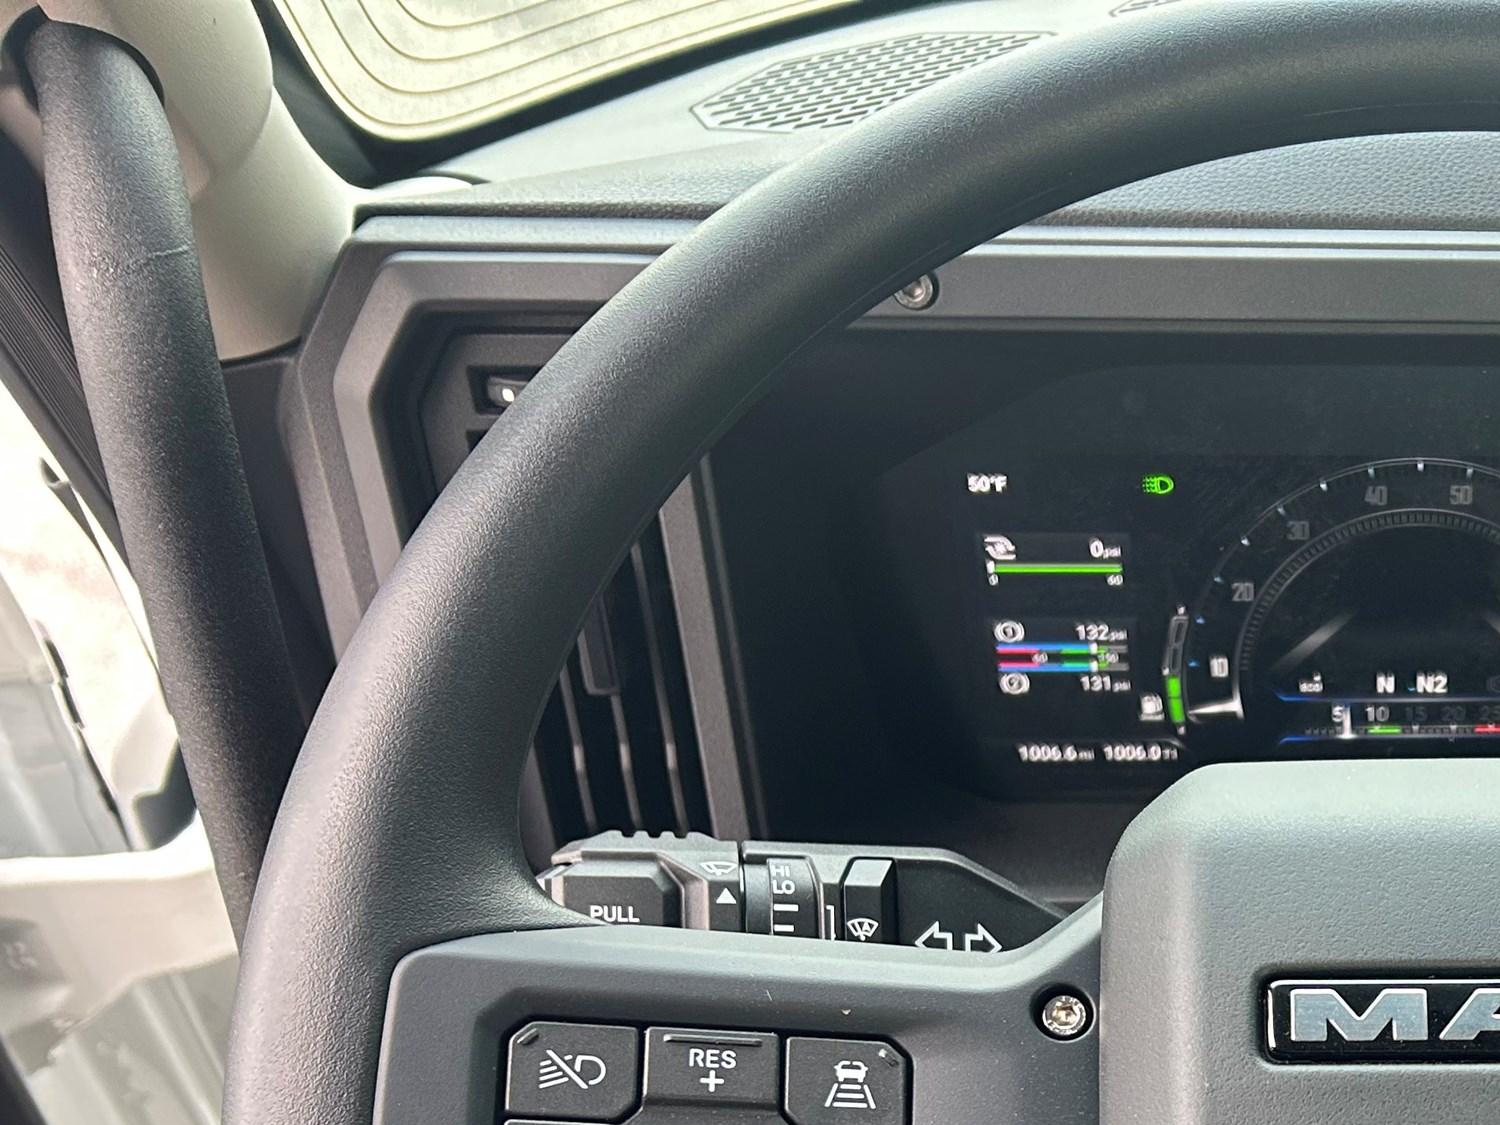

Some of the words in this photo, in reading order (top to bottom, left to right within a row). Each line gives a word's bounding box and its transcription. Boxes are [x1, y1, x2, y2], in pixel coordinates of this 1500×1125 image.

[1365, 486, 1388, 506] 40
[1450, 485, 1473, 504] 50
[1287, 521, 1310, 540] 30
[1231, 582, 1254, 602] 20
[1076, 624, 1109, 640] 132
[1210, 656, 1229, 677] 10
[1080, 674, 1111, 691] 131
[1376, 672, 1395, 693] N
[1416, 672, 1448, 693] N2
[1366, 705, 1390, 722] 10
[772, 864, 791, 877] HI
[773, 880, 796, 895] LO
[590, 904, 640, 924] PULL
[689, 1048, 737, 1068] RES
